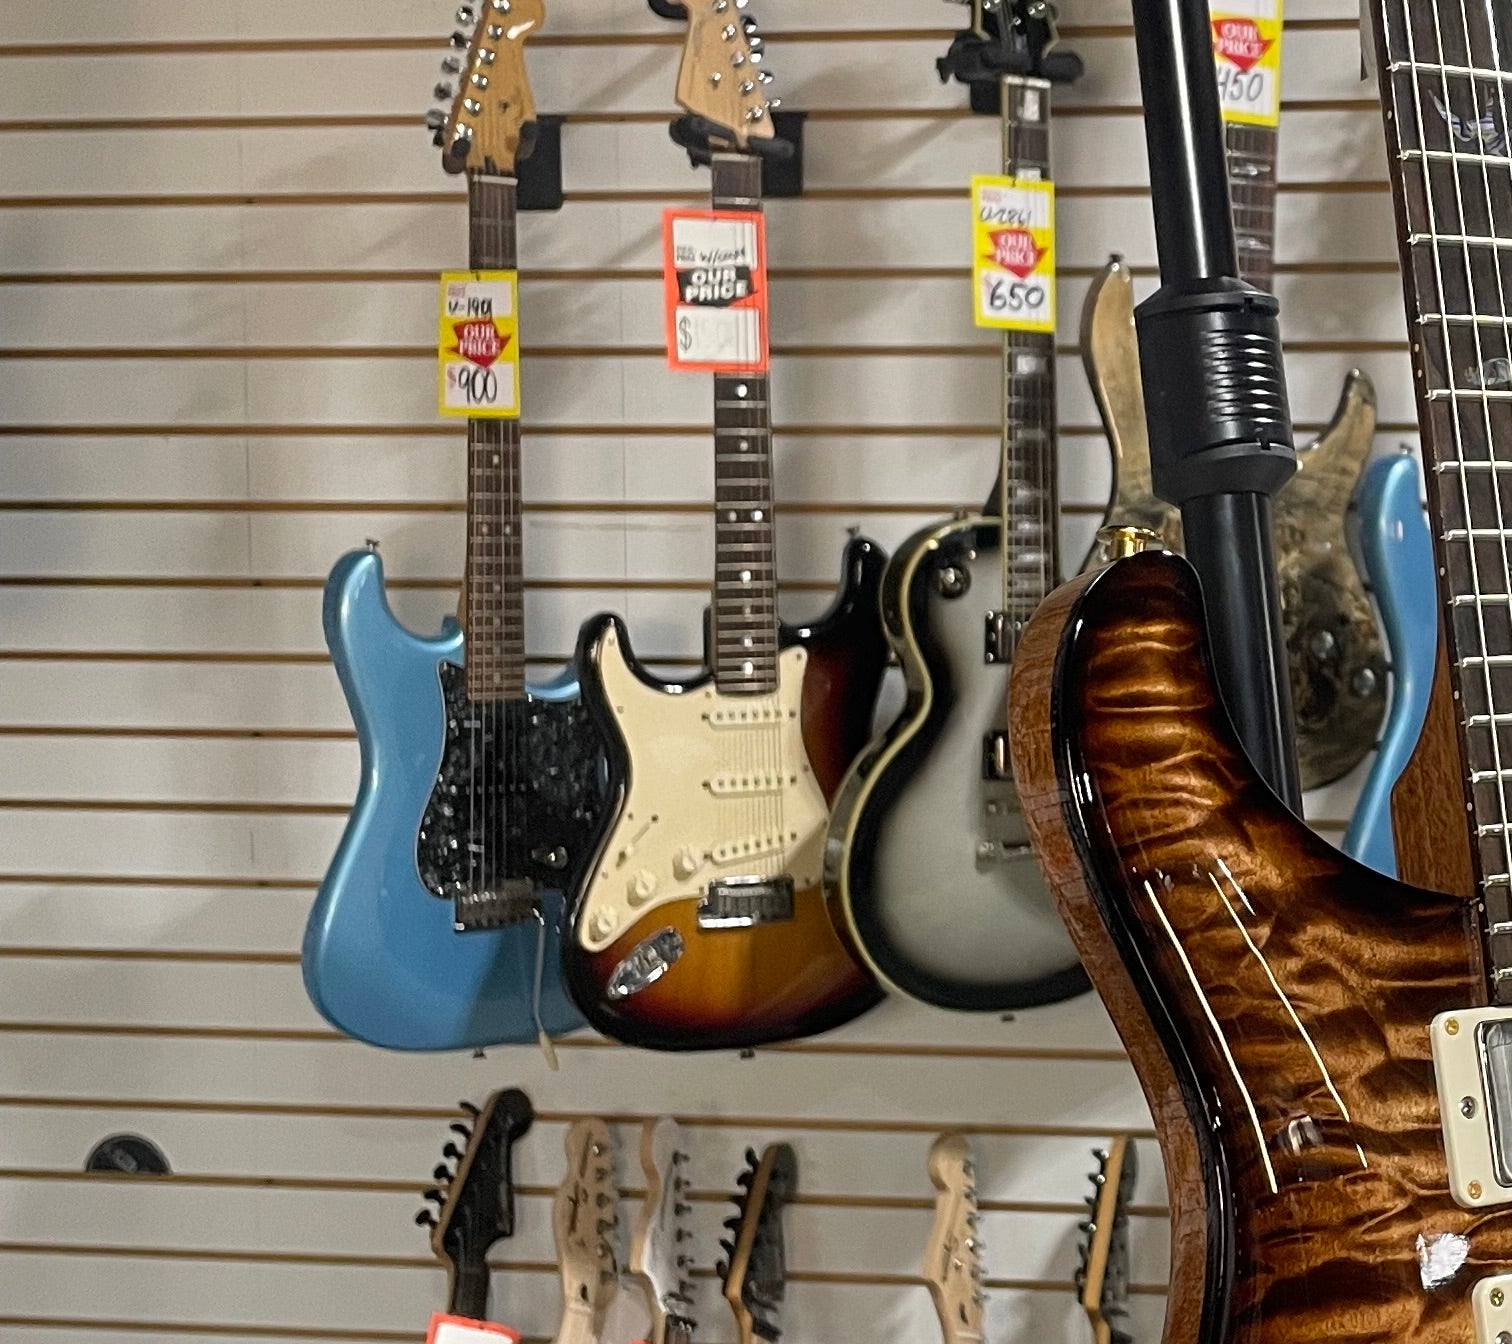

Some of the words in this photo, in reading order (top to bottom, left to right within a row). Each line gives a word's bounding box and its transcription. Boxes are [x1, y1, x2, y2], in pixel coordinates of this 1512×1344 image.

[1221, 23, 1258, 41] OUR
[1217, 38, 1264, 57] PRICE
[1000, 234, 1033, 248] OUR
[996, 248, 1035, 265] PRICE
[690, 268, 737, 287] OUR
[684, 281, 749, 304] PRICE
[463, 323, 495, 340] OUR
[458, 338, 501, 356] PRICE
